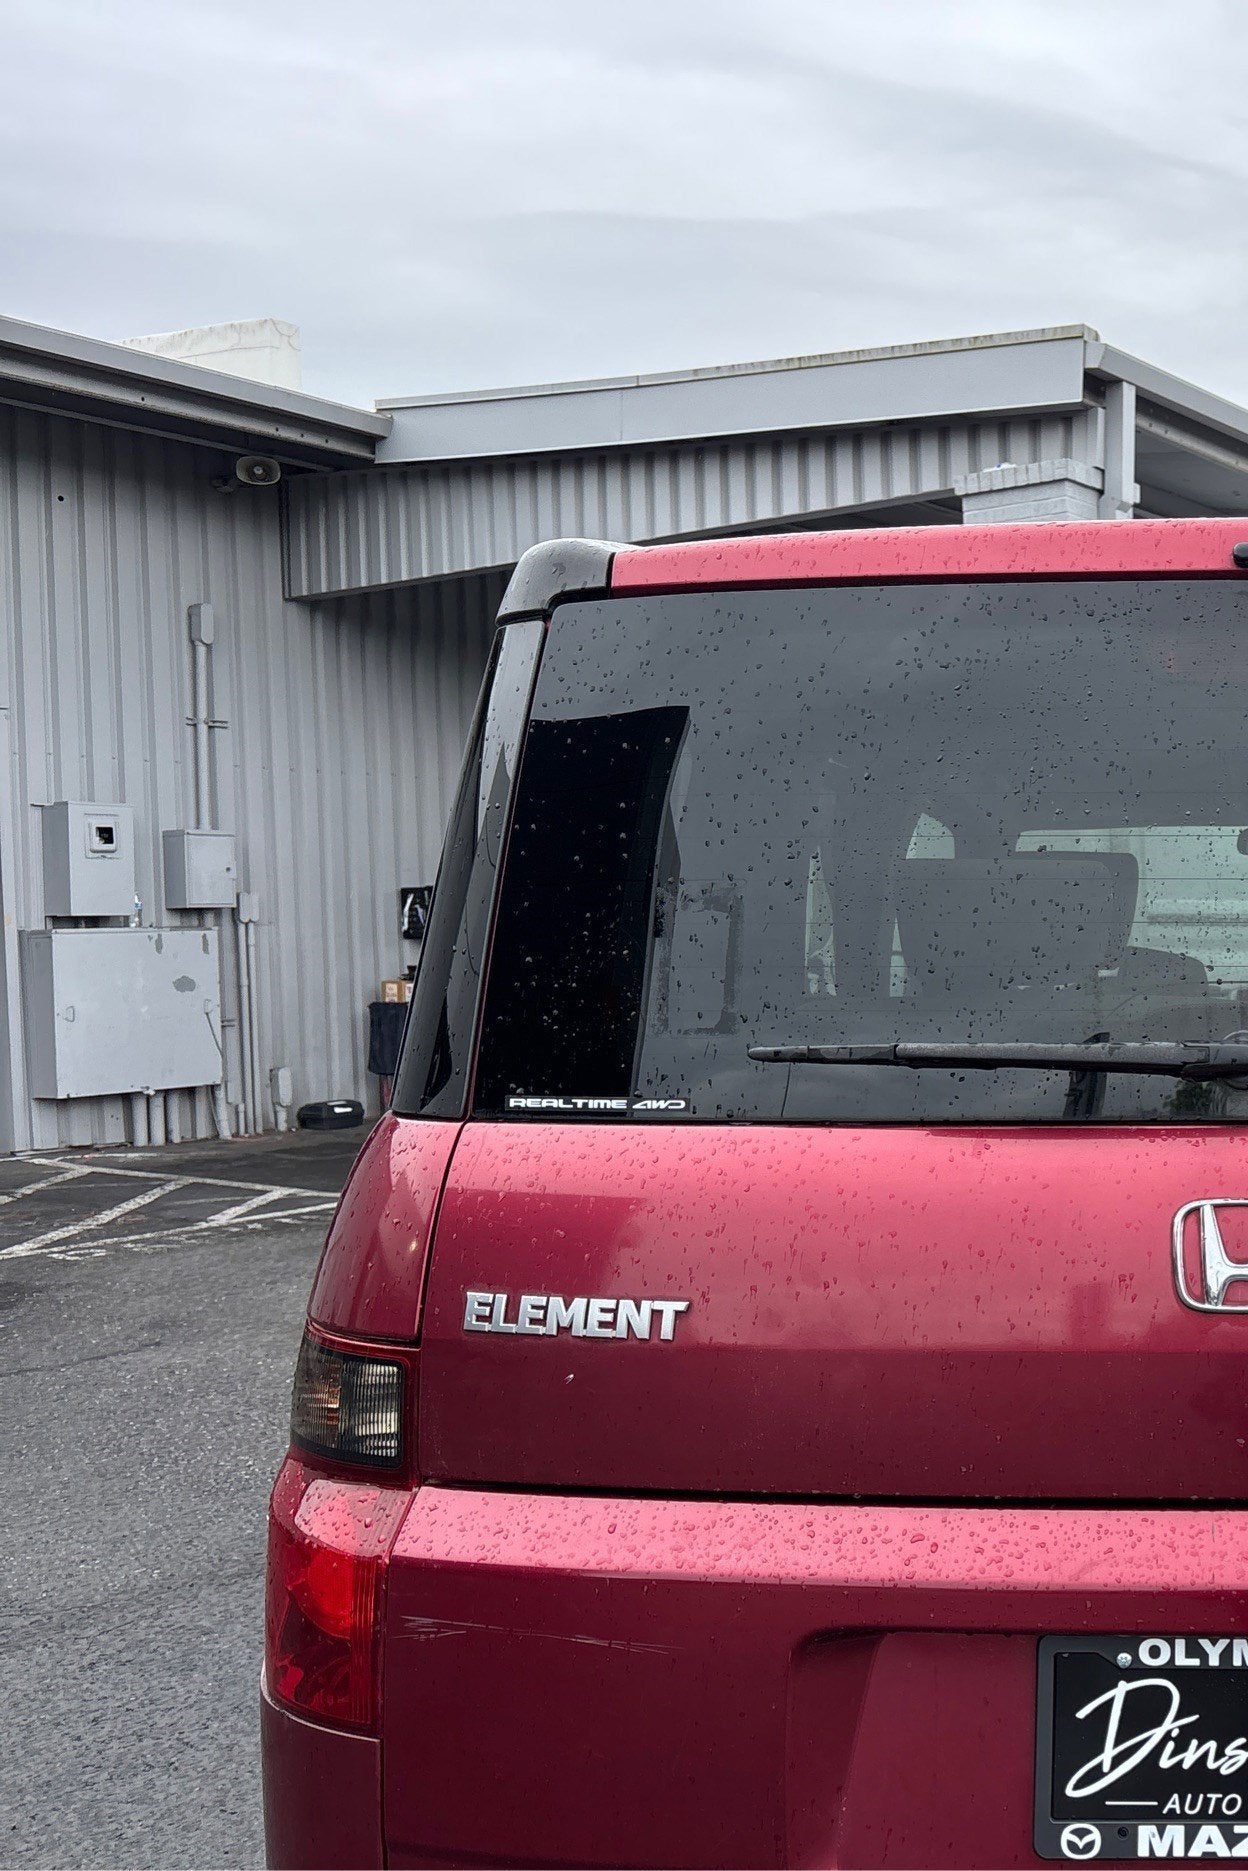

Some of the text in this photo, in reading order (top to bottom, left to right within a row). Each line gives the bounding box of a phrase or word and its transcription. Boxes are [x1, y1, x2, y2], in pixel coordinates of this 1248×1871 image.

[509, 1097, 628, 1109] REALTIME
[463, 1291, 690, 1341] ELEMENT
[1162, 1793, 1242, 1815] AUTO
